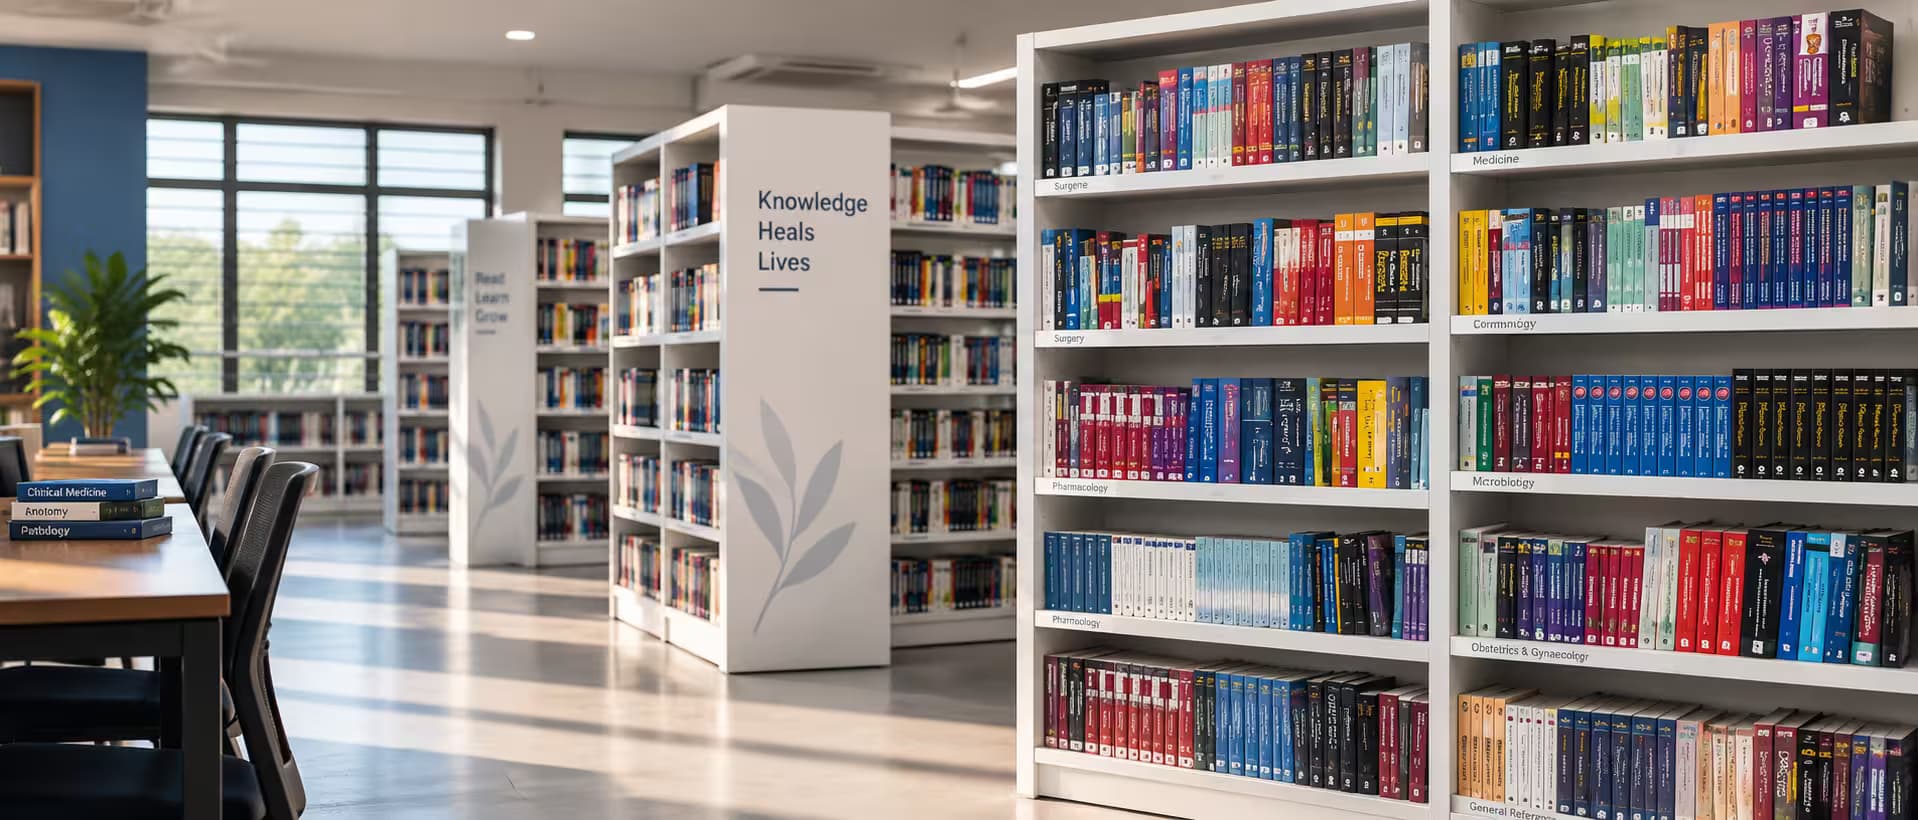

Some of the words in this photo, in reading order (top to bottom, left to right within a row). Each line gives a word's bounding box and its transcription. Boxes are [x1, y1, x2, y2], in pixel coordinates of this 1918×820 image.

[1473, 154, 1520, 166] Medicine
[758, 190, 868, 217] Knowledge
[758, 221, 815, 241] Heals
[758, 251, 811, 272] Lives
[65, 487, 107, 497] Medicine
[1052, 481, 1109, 495] Pharmacology
[1469, 801, 1507, 817] General
